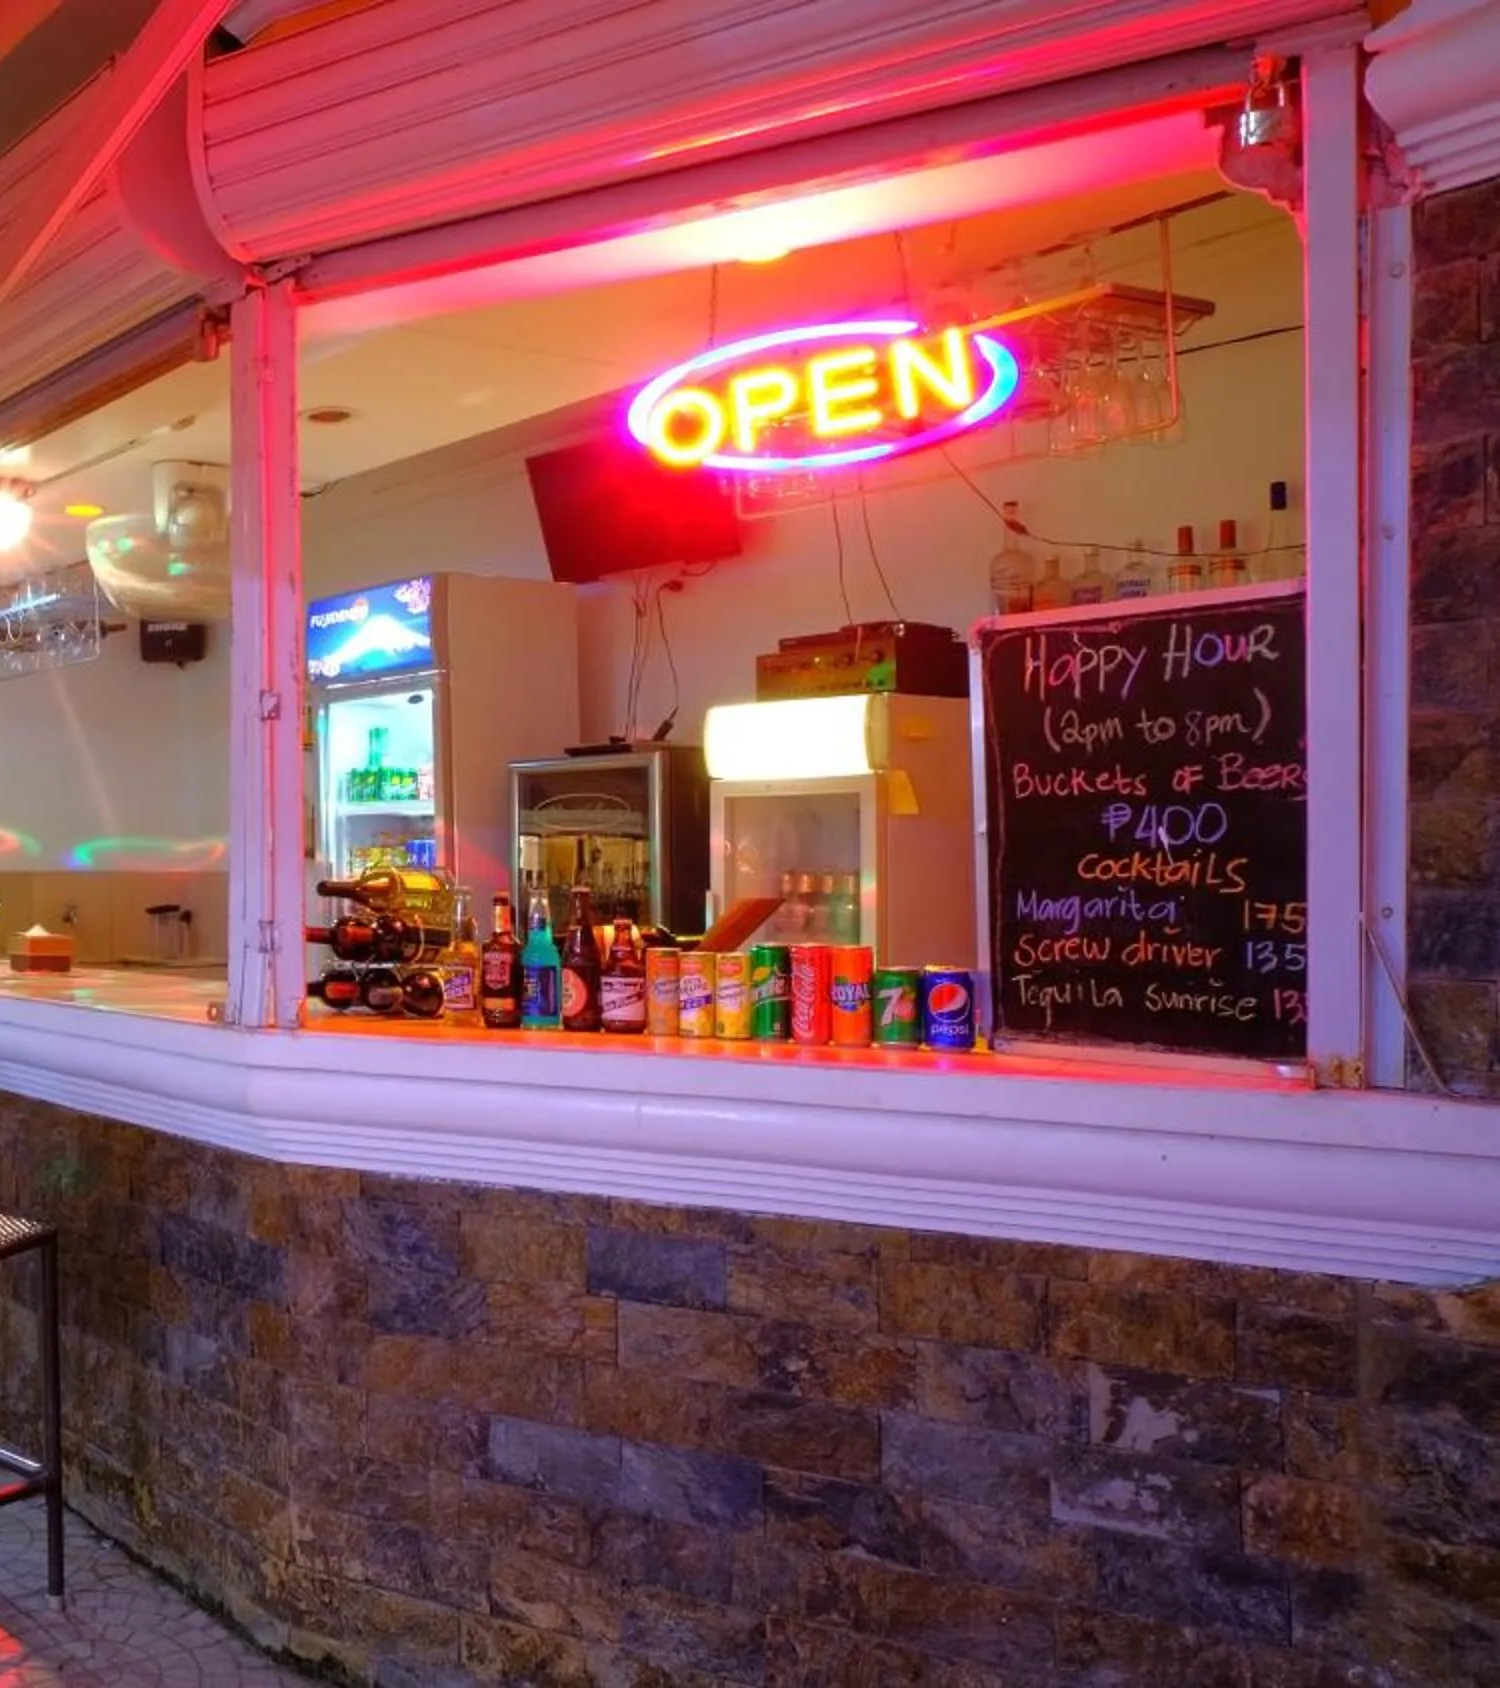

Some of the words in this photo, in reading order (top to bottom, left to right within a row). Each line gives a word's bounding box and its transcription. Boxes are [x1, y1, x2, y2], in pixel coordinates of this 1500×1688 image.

[647, 326, 974, 468] OPEN
[1043, 706, 1124, 753] (2pm
[1135, 708, 1177, 744] to
[1185, 687, 1272, 746] 8pm)
[1017, 886, 1177, 935] Margarita
[1244, 900, 1307, 933] 175
[1014, 934, 1112, 967] Screw
[1120, 927, 1224, 968] driver
[1247, 941, 1306, 973] 135
[1012, 971, 1124, 1026] Tequila
[1145, 977, 1258, 1021] Sunrise
[1273, 988, 1307, 1026] 13
[931, 1023, 970, 1037] pepsi
